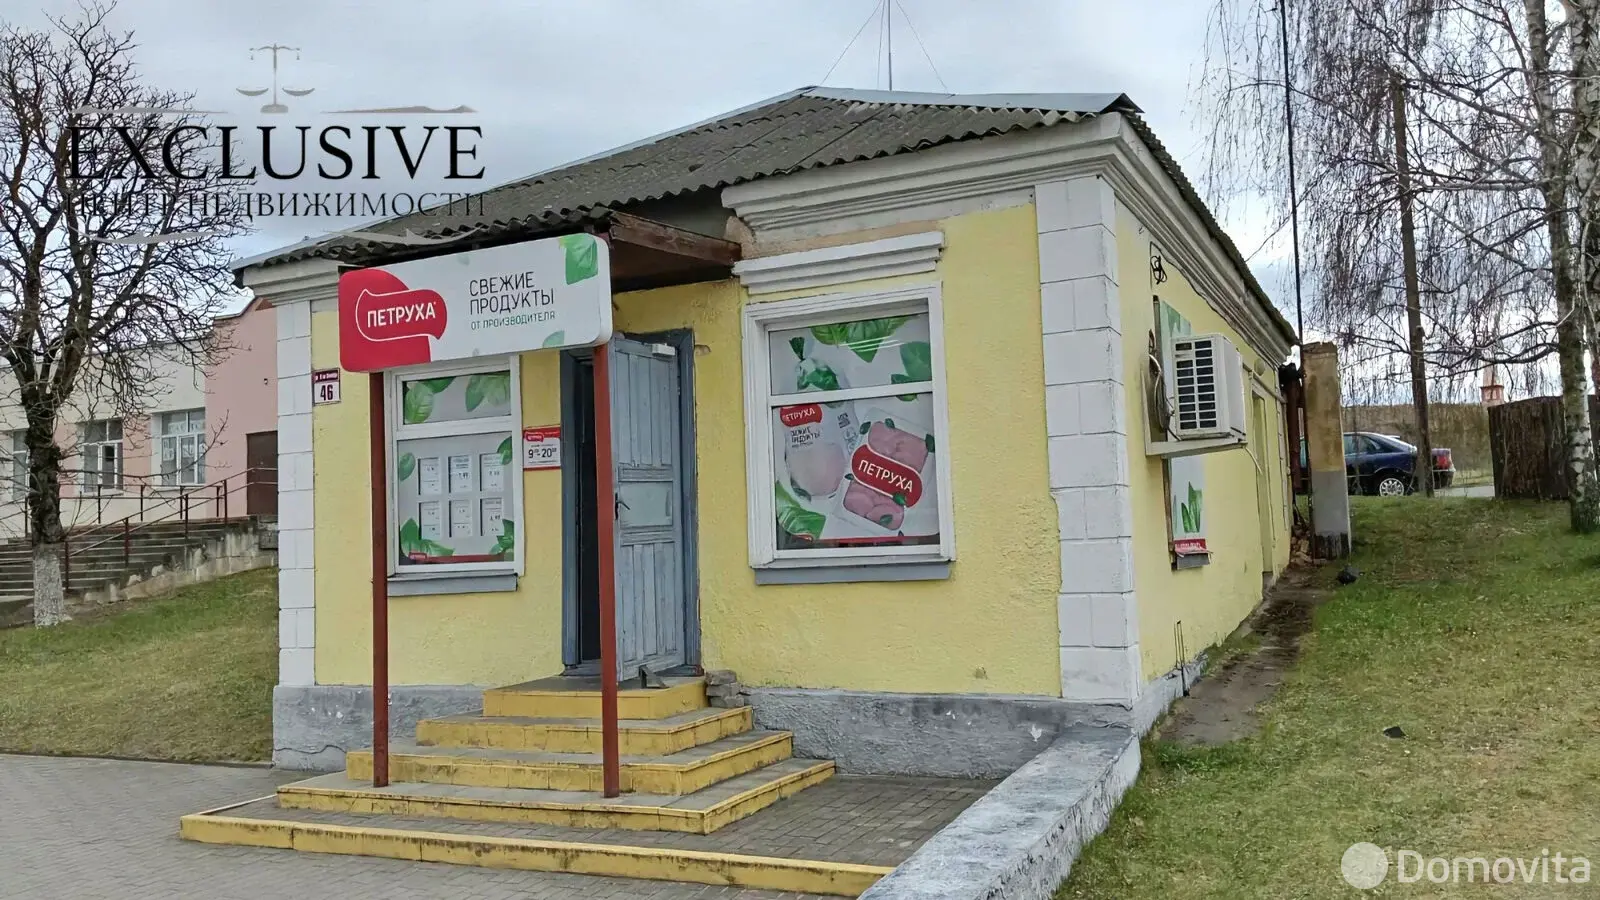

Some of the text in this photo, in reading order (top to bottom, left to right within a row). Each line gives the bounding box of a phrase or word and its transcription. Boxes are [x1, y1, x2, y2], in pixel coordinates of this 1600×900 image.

[469, 271, 535, 297] СВЕЖИЕ
[469, 288, 554, 315] ПРОДУКТЫ
[366, 302, 437, 328] ПЕТРУХА
[470, 311, 556, 331] ОТ ПРОИЗВОДИТЕЛЯ
[320, 384, 334, 401] 46
[858, 459, 914, 493] ПЕТРУХА
